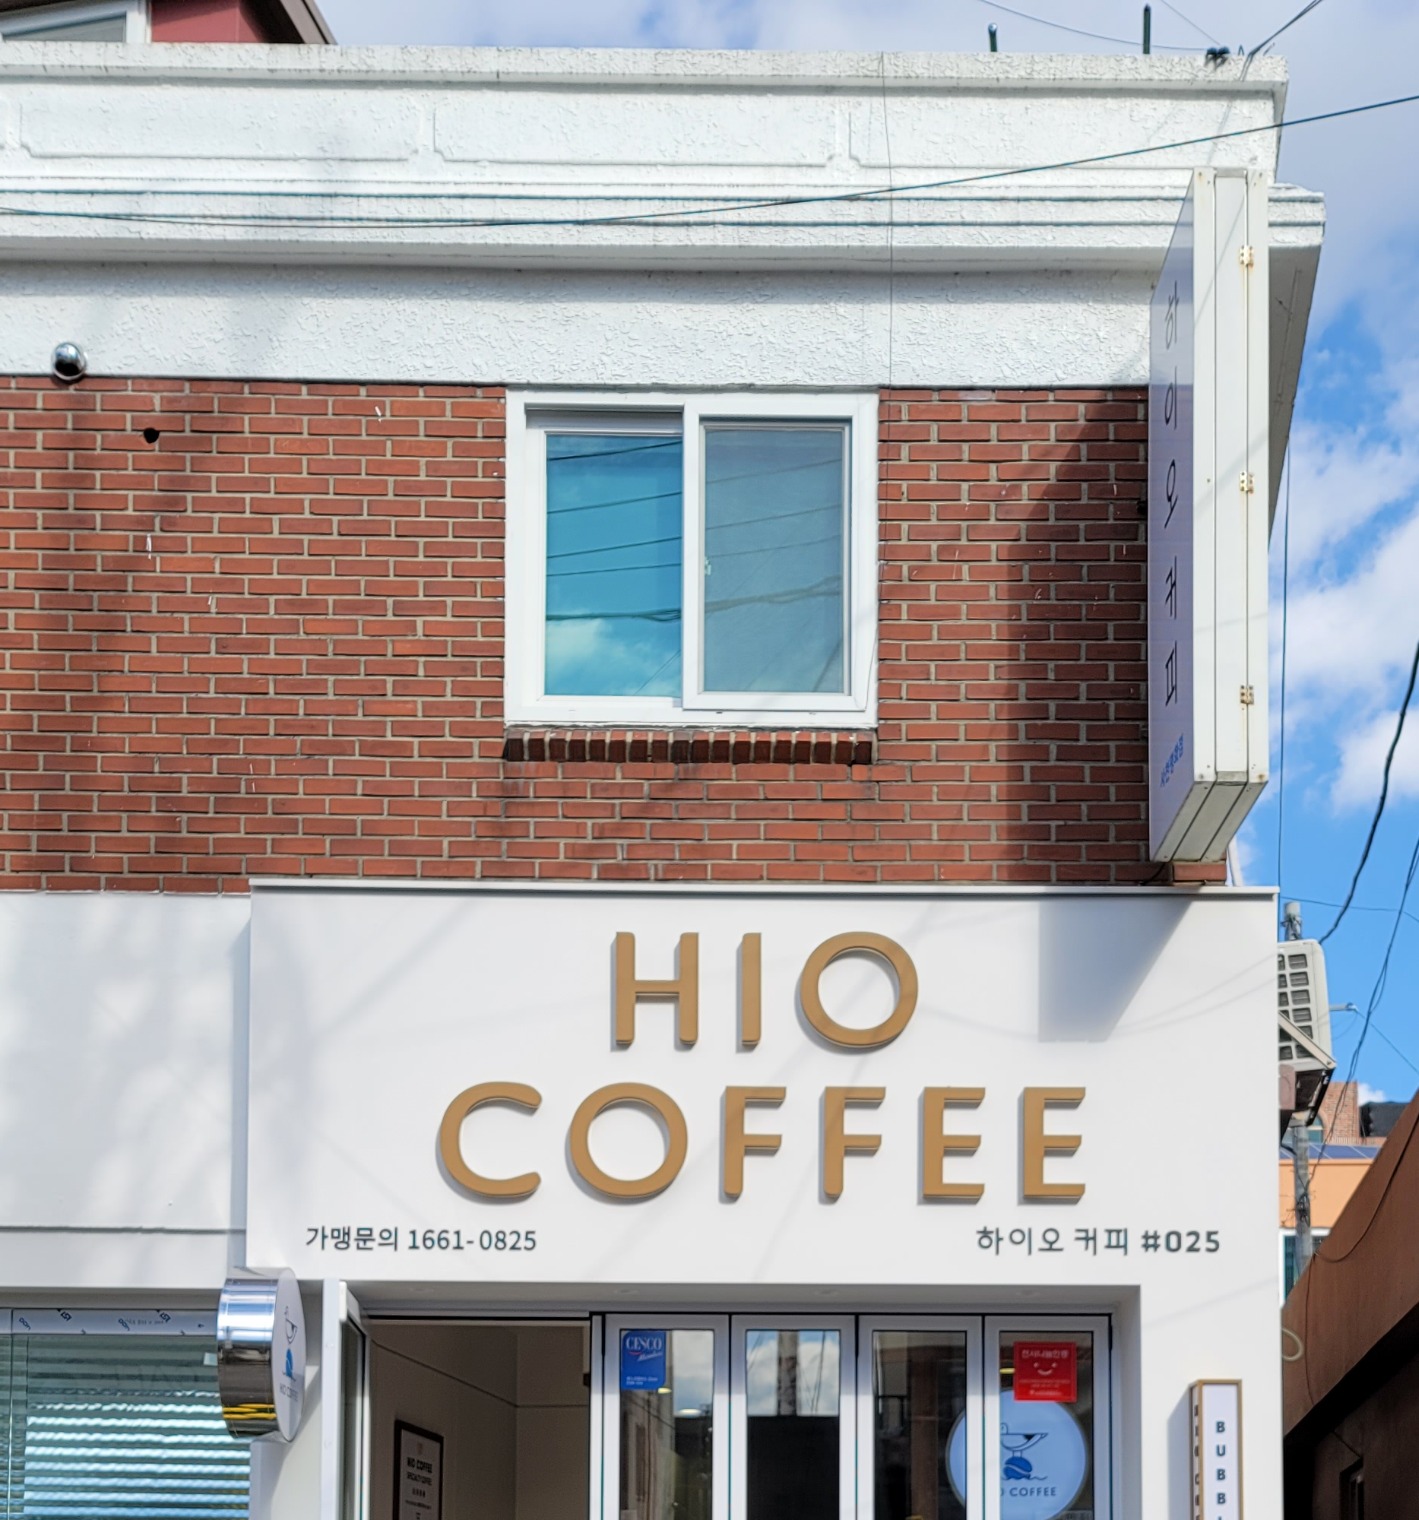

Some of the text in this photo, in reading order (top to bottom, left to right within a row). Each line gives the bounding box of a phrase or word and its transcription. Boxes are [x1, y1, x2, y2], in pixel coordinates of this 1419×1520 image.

[614, 932, 918, 1049] HIO
[437, 1081, 1086, 1200] COFFEE
[305, 1225, 399, 1252] 가맹문의
[976, 1226, 1220, 1256] 하이오 커피 #025
[626, 1336, 663, 1350] CESCO
[1009, 1486, 1057, 1497] COFFEE
